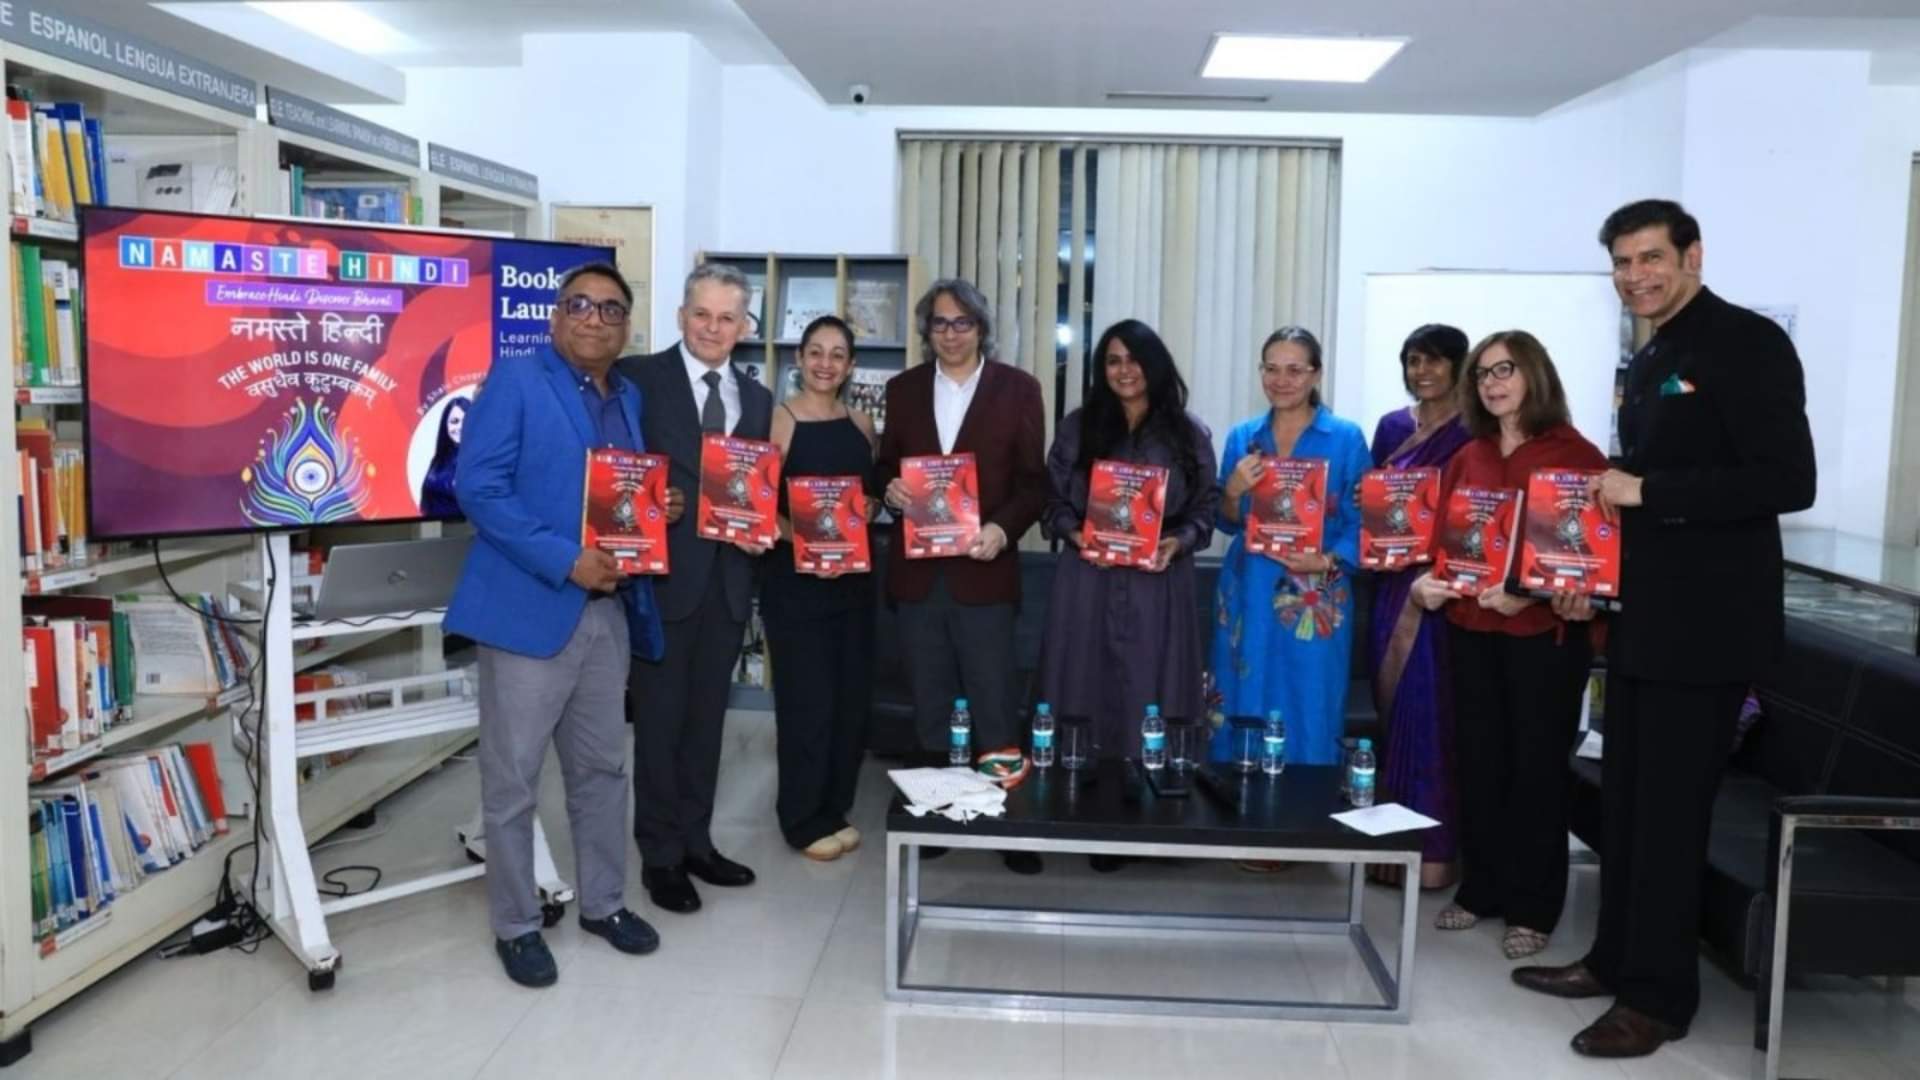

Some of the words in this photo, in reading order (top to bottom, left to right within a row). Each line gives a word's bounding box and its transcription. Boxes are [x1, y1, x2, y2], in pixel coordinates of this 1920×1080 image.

[29, 11, 112, 60] ESPANOL
[115, 42, 176, 83] LENGUA
[178, 64, 256, 107] EXTRANJERA
[129, 242, 319, 274] NAMASTE
[348, 257, 459, 283] HINDI
[501, 265, 561, 290] Book
[230, 312, 310, 343] नमस्ते
[319, 312, 384, 344] हिन्दी
[500, 331, 552, 344] Learnin
[218, 366, 249, 390] THE
[248, 352, 301, 375] WORLD
[305, 351, 319, 366] IS
[322, 351, 352, 371] ONE
[352, 360, 398, 393] FAMILY
[245, 369, 300, 398] वसुधैव
